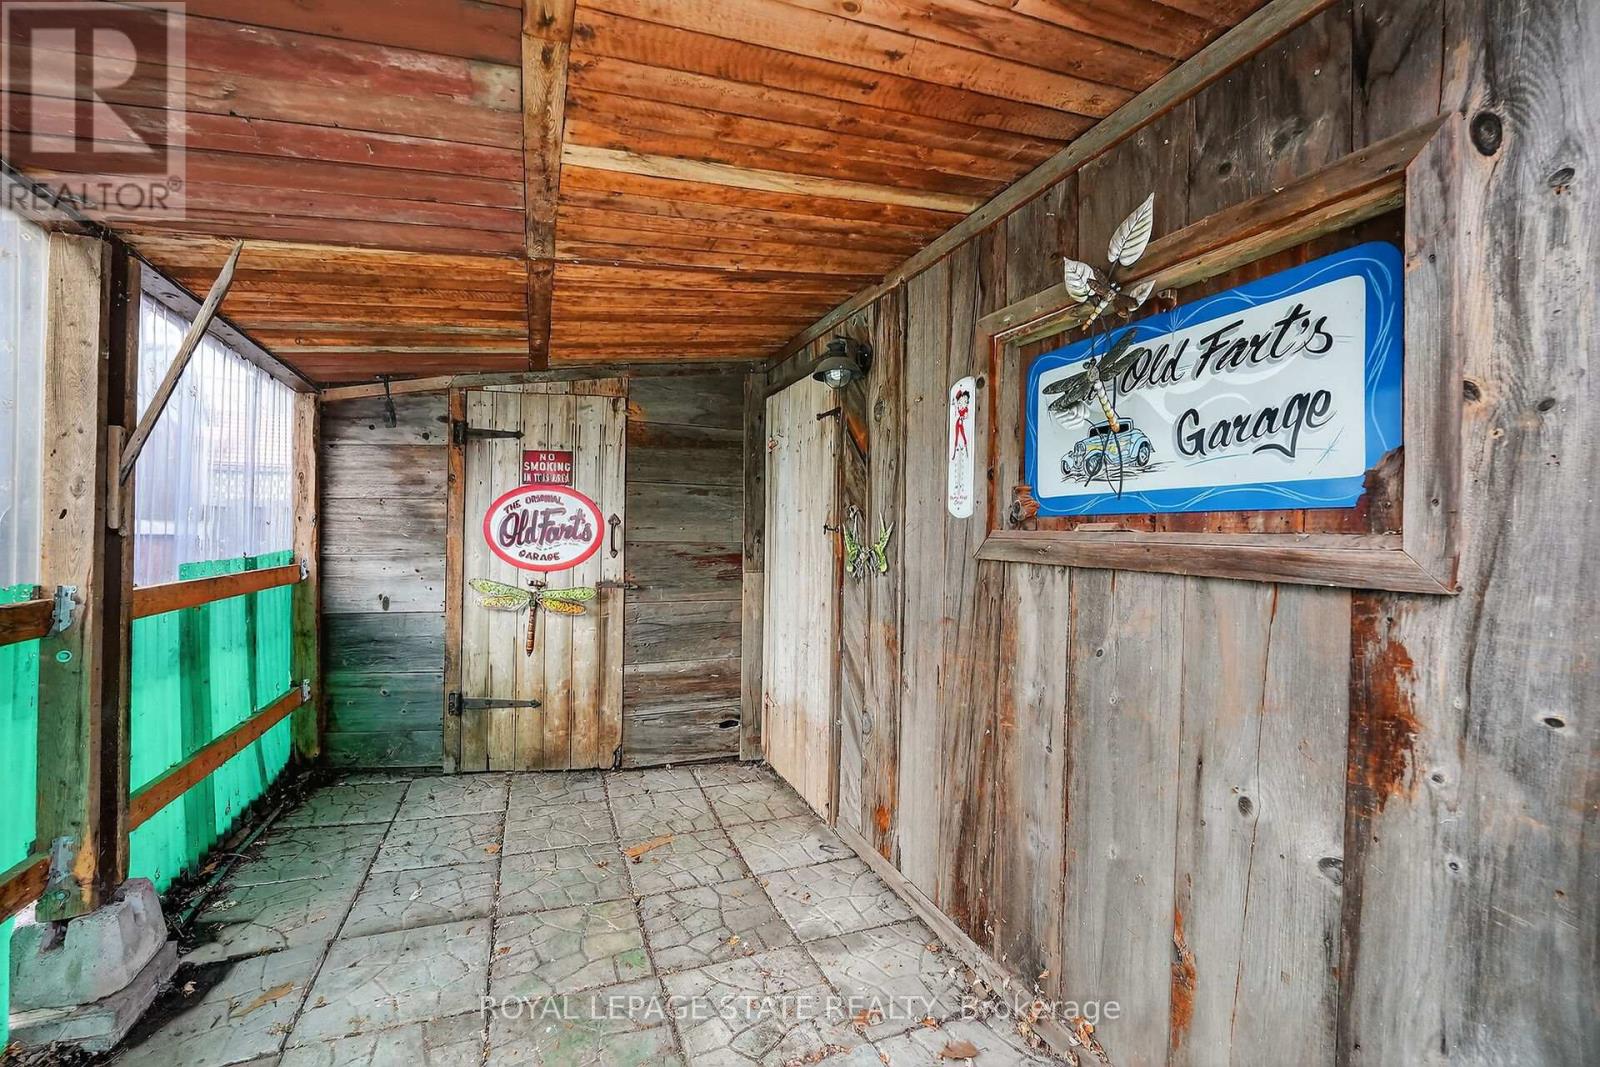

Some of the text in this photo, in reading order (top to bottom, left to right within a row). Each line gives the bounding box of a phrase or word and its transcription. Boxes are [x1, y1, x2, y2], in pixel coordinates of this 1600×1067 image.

[1120, 303, 1333, 396] Old Fart's
[1176, 388, 1333, 458] Garage
[539, 453, 555, 461] NO
[523, 461, 571, 472] SMOKING
[503, 500, 521, 514] THE
[518, 549, 561, 561] GARAGE
